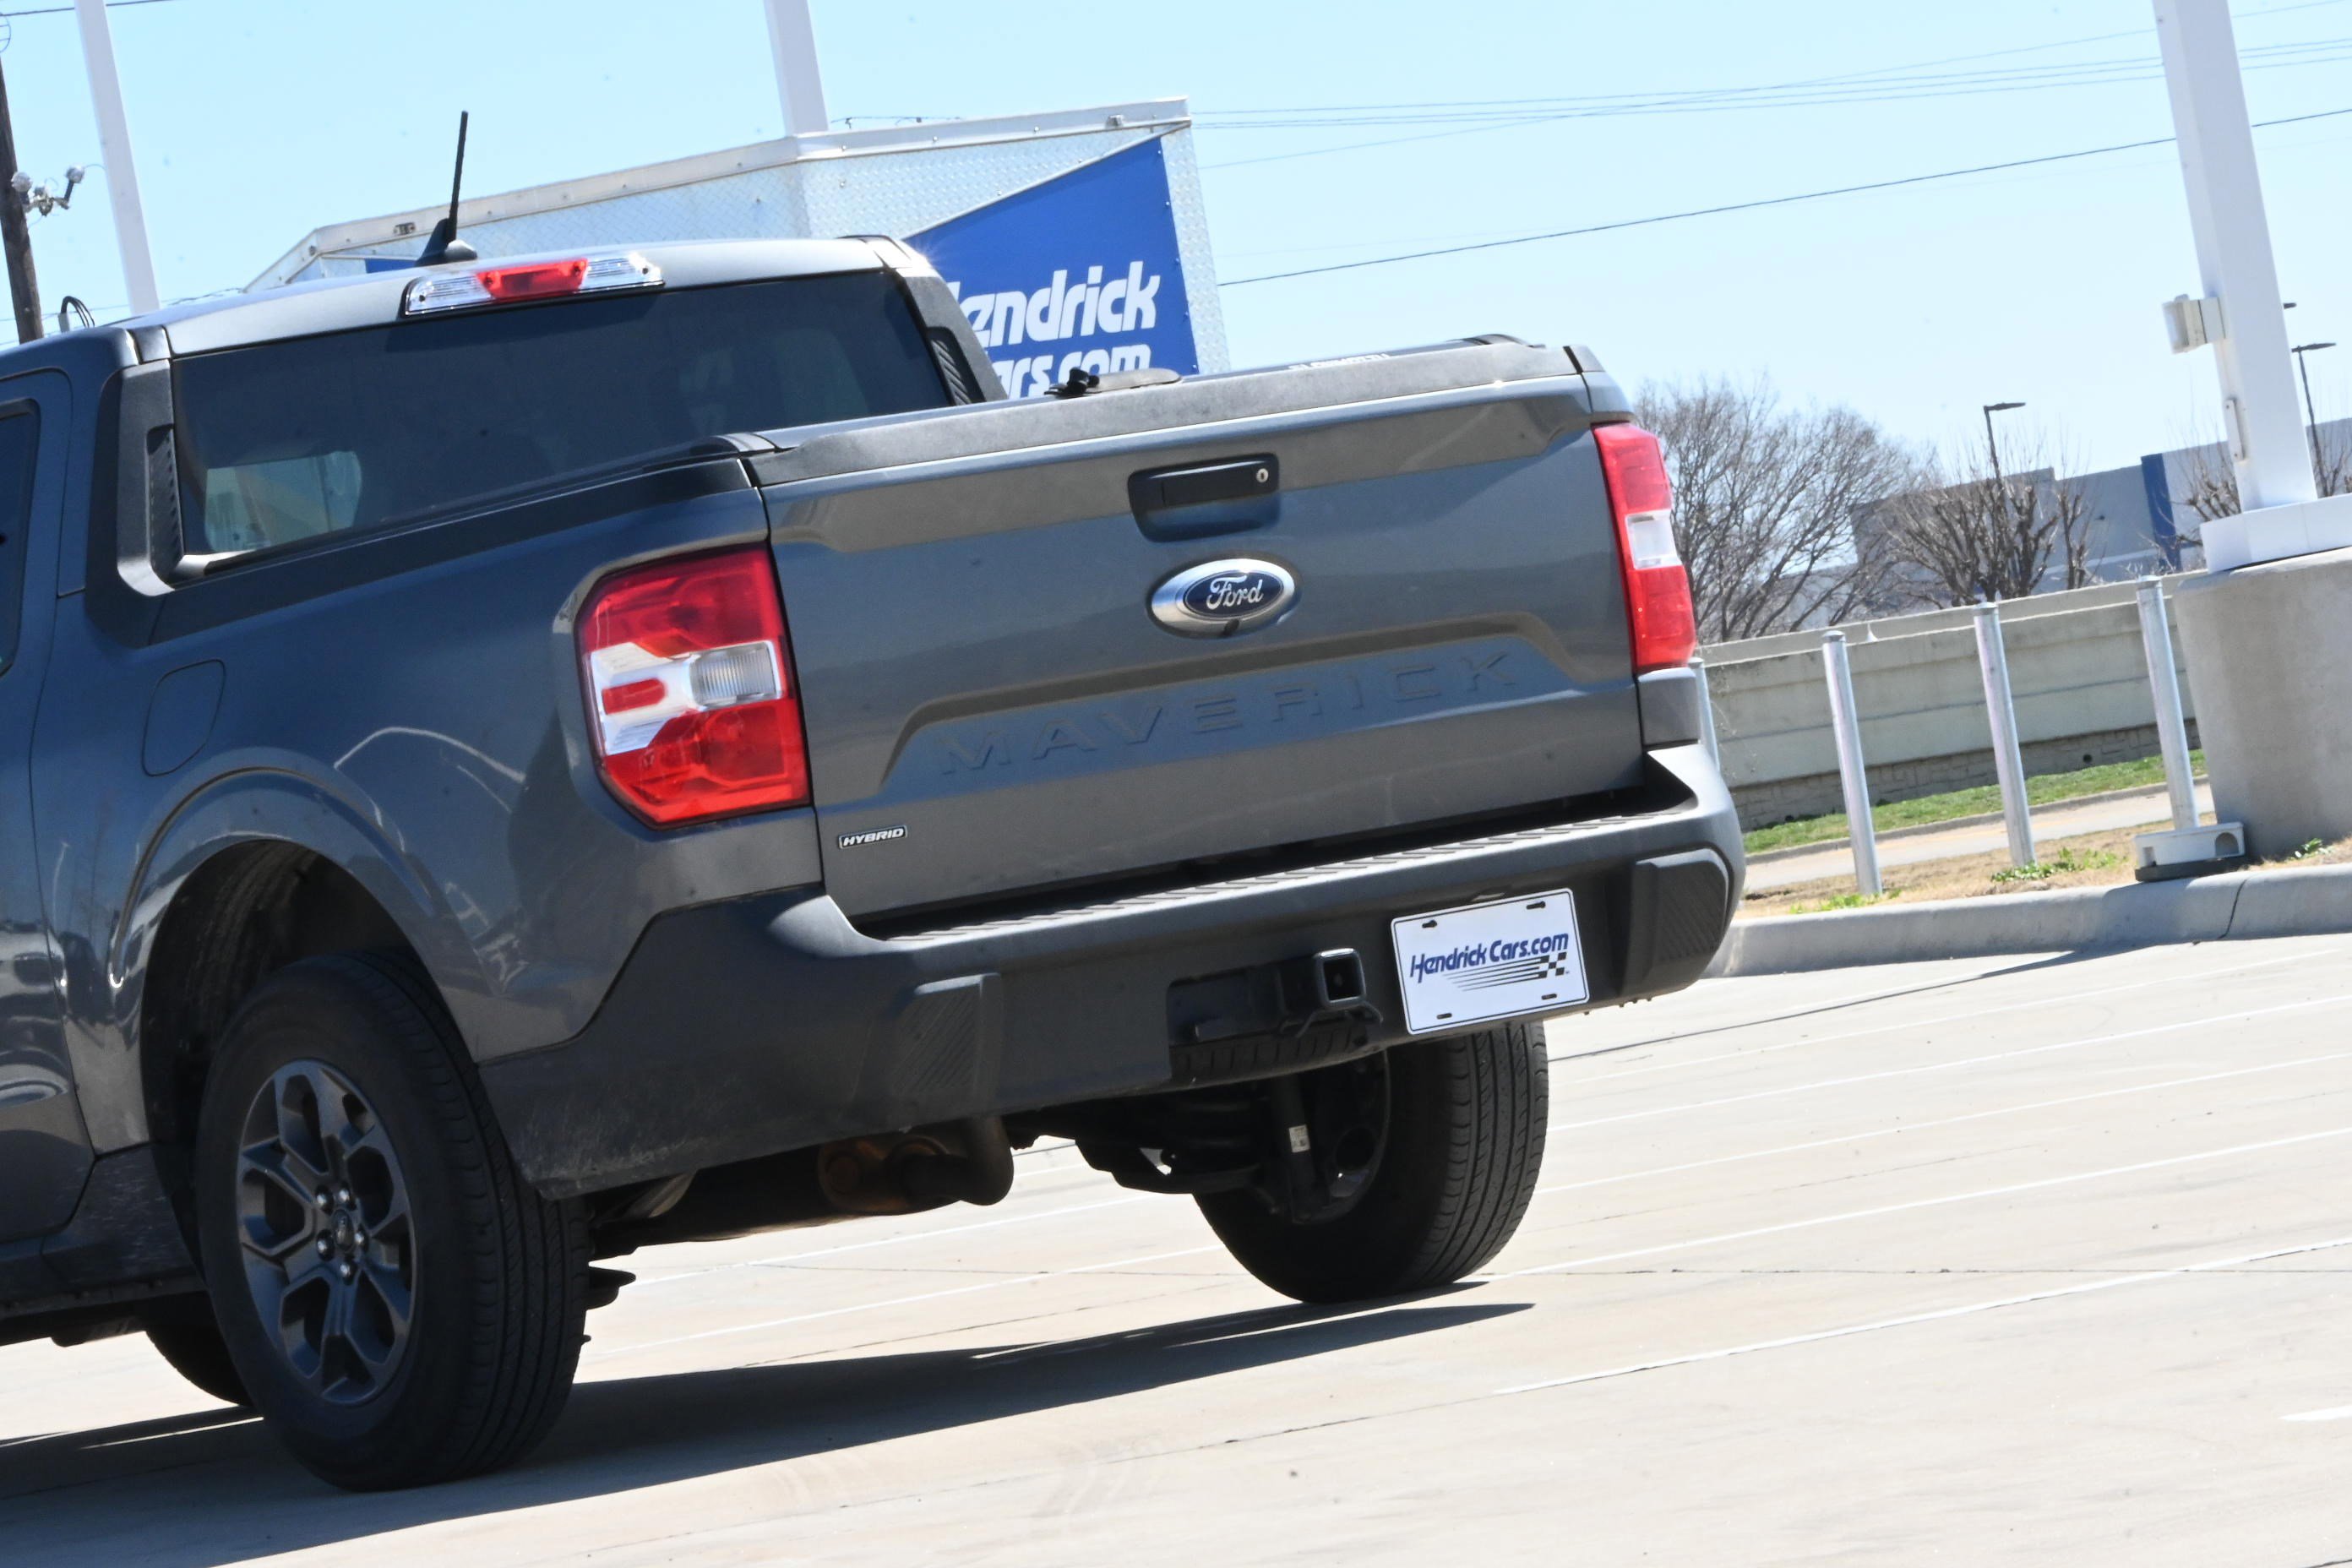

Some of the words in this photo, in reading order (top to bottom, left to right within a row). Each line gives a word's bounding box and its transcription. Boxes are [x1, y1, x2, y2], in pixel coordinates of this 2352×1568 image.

[947, 260, 1161, 348] endrick
[1206, 574, 1264, 610] Ford
[941, 651, 1517, 776] MAVERICK
[843, 828, 904, 847] HYBRID
